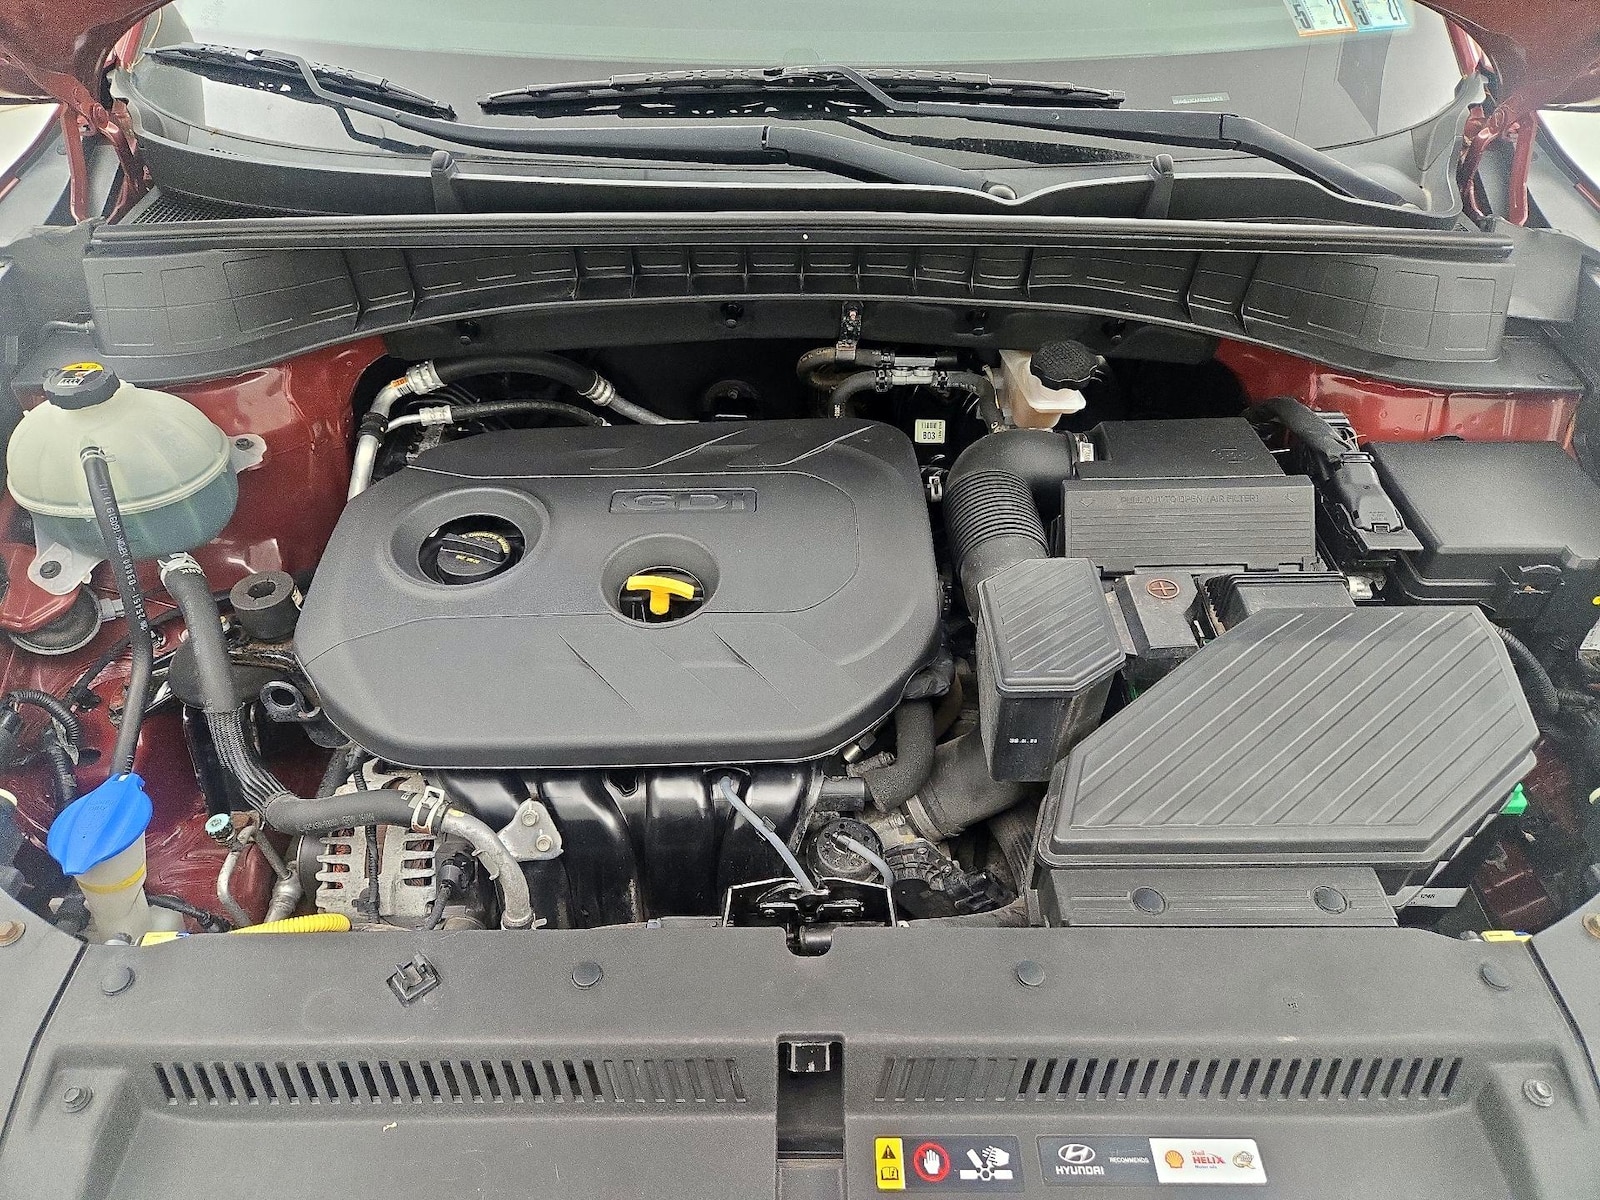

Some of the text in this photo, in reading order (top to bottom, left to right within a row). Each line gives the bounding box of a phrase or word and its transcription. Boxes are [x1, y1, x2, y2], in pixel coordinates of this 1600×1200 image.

[1109, 1156, 1150, 1164] RECOMMENDS
[1192, 1156, 1226, 1165] HELIX
[1055, 1165, 1105, 1175] HYUNDAI
